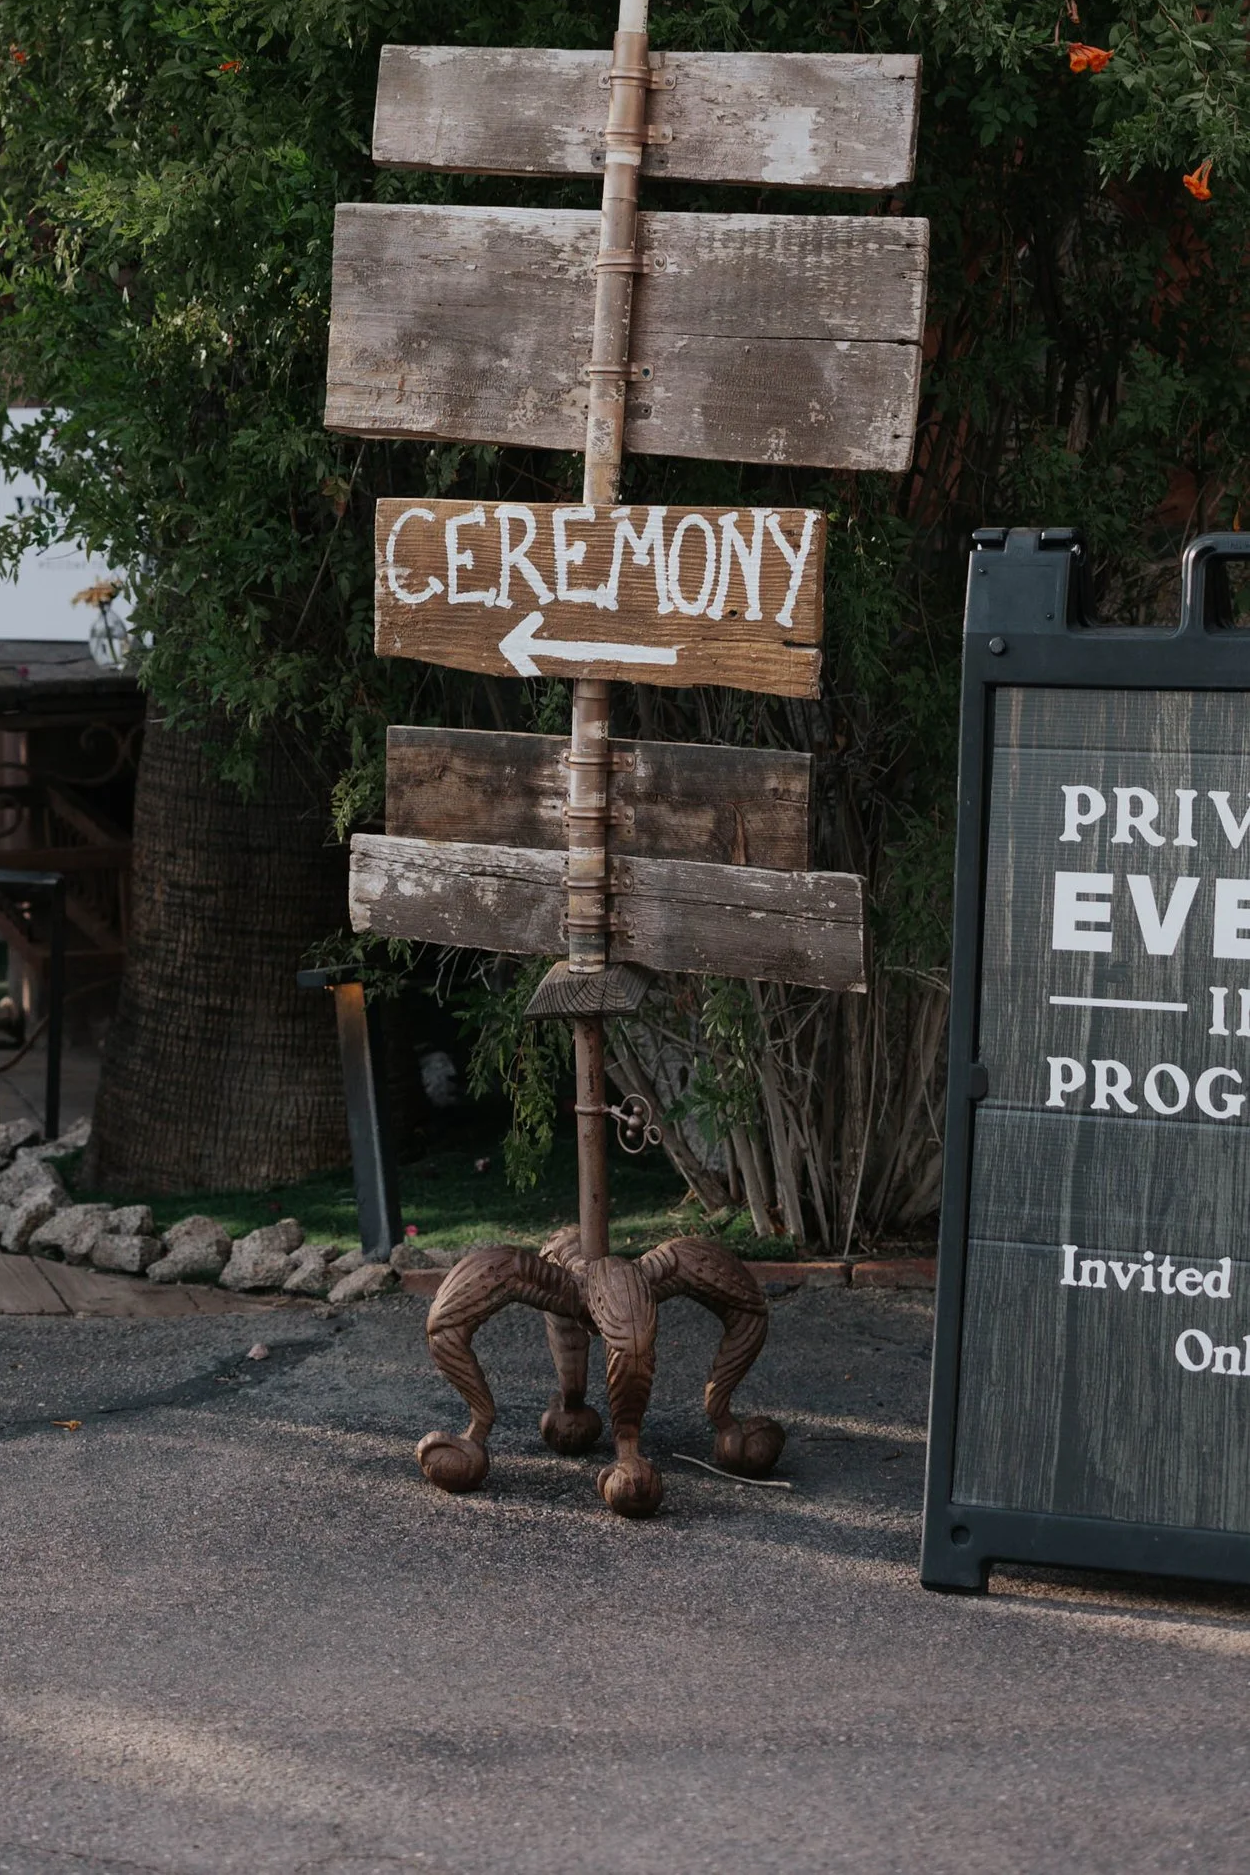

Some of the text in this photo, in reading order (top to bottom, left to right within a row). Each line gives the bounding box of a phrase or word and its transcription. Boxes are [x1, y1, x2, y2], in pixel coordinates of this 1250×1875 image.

[385, 505, 819, 627] CEREMONY
[1059, 785, 1250, 849] PRIV
[1052, 871, 1250, 960] EVE
[1046, 1056, 1246, 1119] PROG
[1060, 1244, 1232, 1299] Invited
